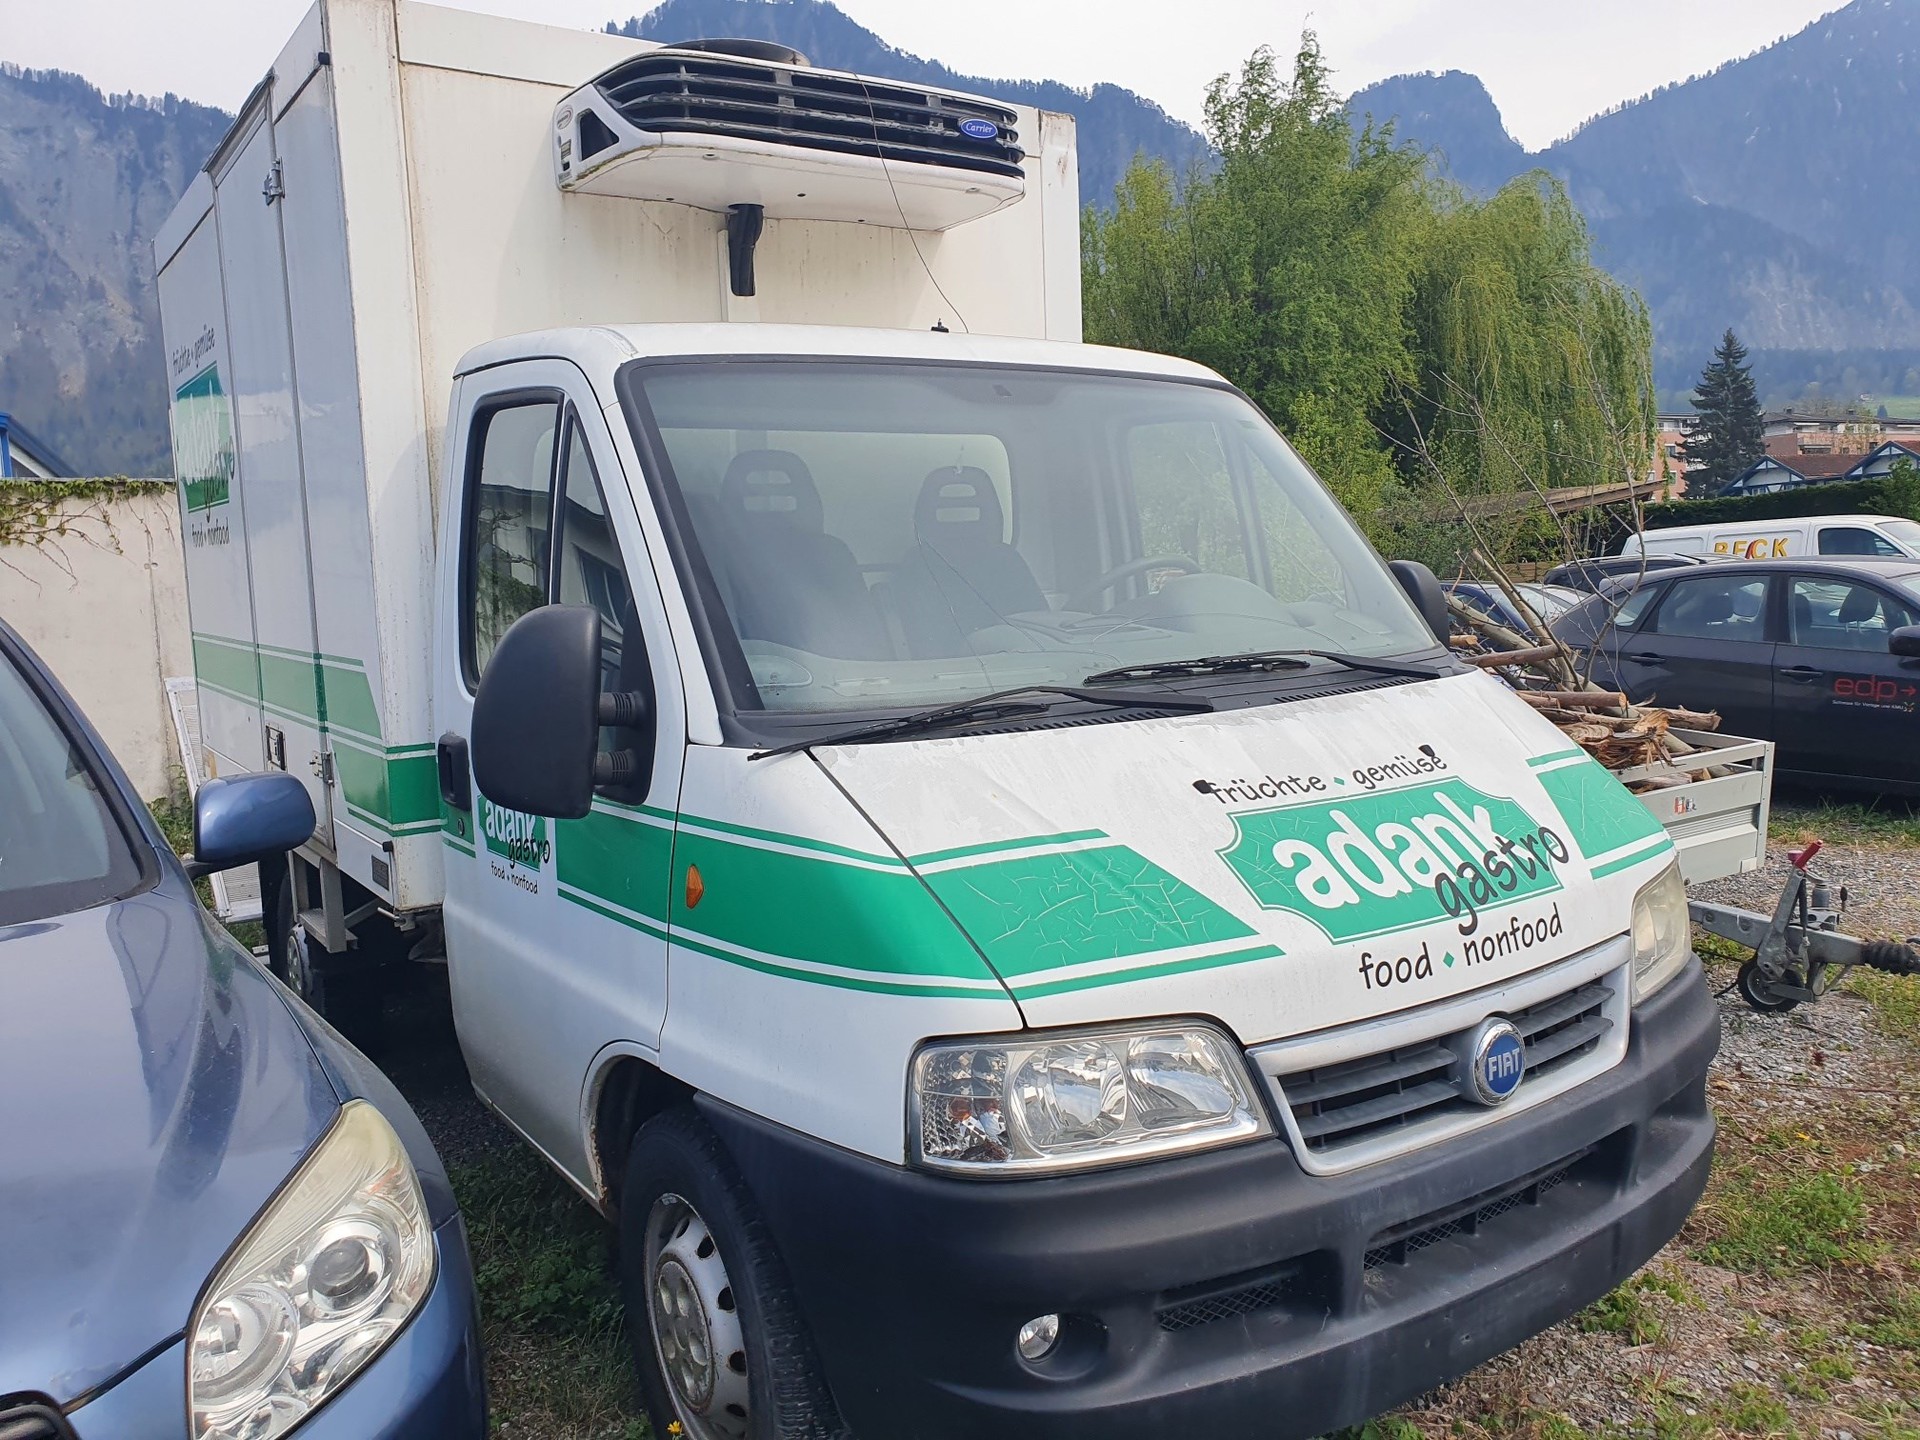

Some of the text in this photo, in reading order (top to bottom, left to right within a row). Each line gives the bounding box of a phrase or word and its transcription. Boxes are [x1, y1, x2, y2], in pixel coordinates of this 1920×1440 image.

[965, 122, 993, 134] Carrier
[191, 523, 205, 547] food
[1834, 674, 1897, 702] edp
[1207, 752, 1448, 805] früchte gemüse
[508, 833, 551, 870] gastro
[1272, 791, 1522, 911] adank
[490, 860, 539, 895] food nonfood
[1434, 826, 1570, 936] gastro
[1358, 901, 1564, 990] food nonfood
[1487, 1047, 1521, 1082] FIAT
